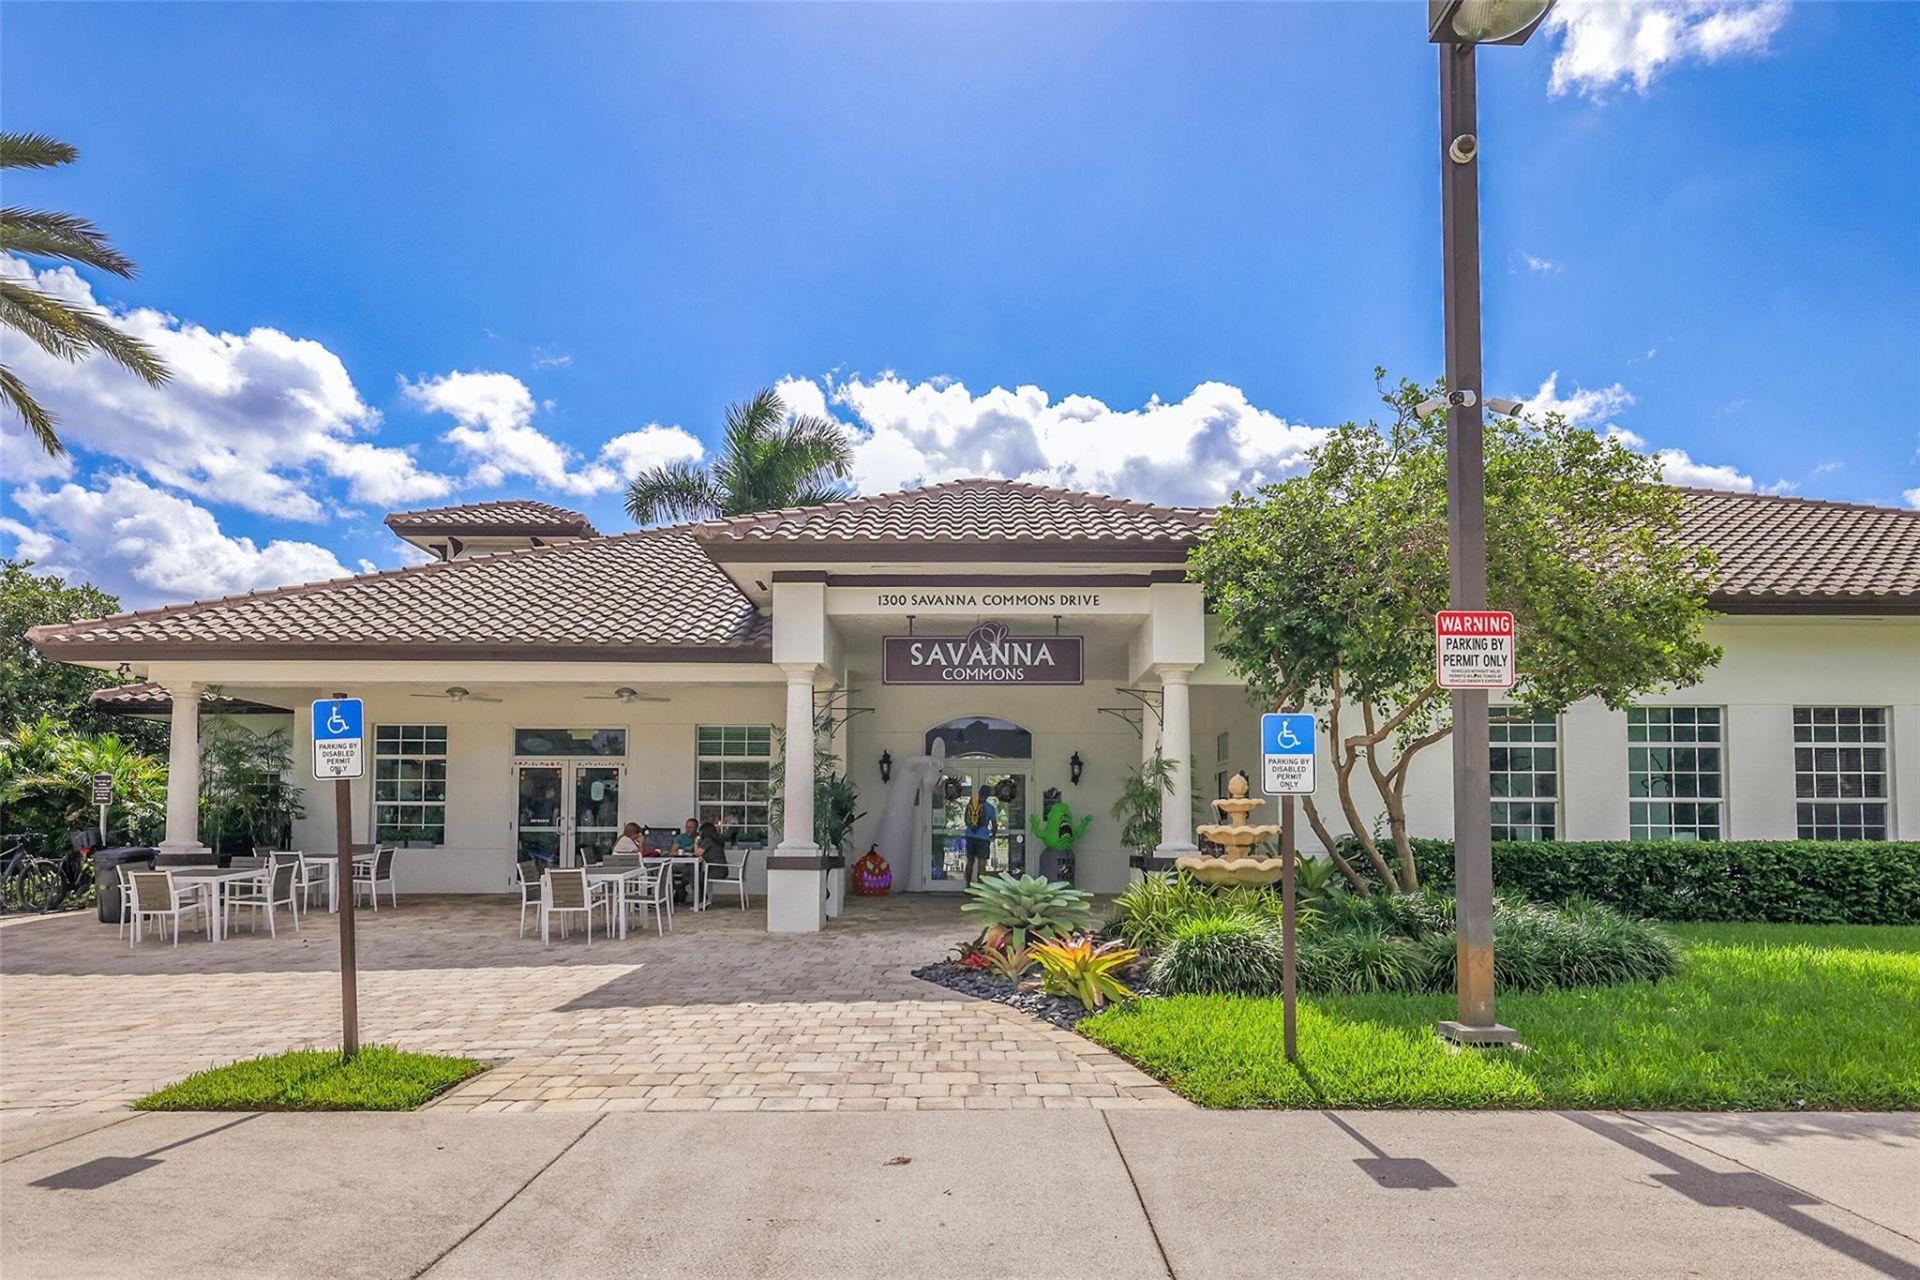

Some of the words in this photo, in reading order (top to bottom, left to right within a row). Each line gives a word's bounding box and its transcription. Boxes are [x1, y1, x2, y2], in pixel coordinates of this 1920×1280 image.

[878, 594, 906, 606] 1300
[911, 594, 977, 606] SAVANNA
[982, 594, 1056, 606] COMMONS
[1060, 594, 1100, 606] DRIVE
[1440, 616, 1510, 632] WARNING
[1446, 638, 1488, 650] PARKING
[1491, 638, 1504, 650] BY
[910, 642, 1056, 666] SAVANNA
[1443, 654, 1480, 667] PERMIT
[1483, 654, 1508, 667] ONLY
[942, 667, 1024, 680] COMMONS
